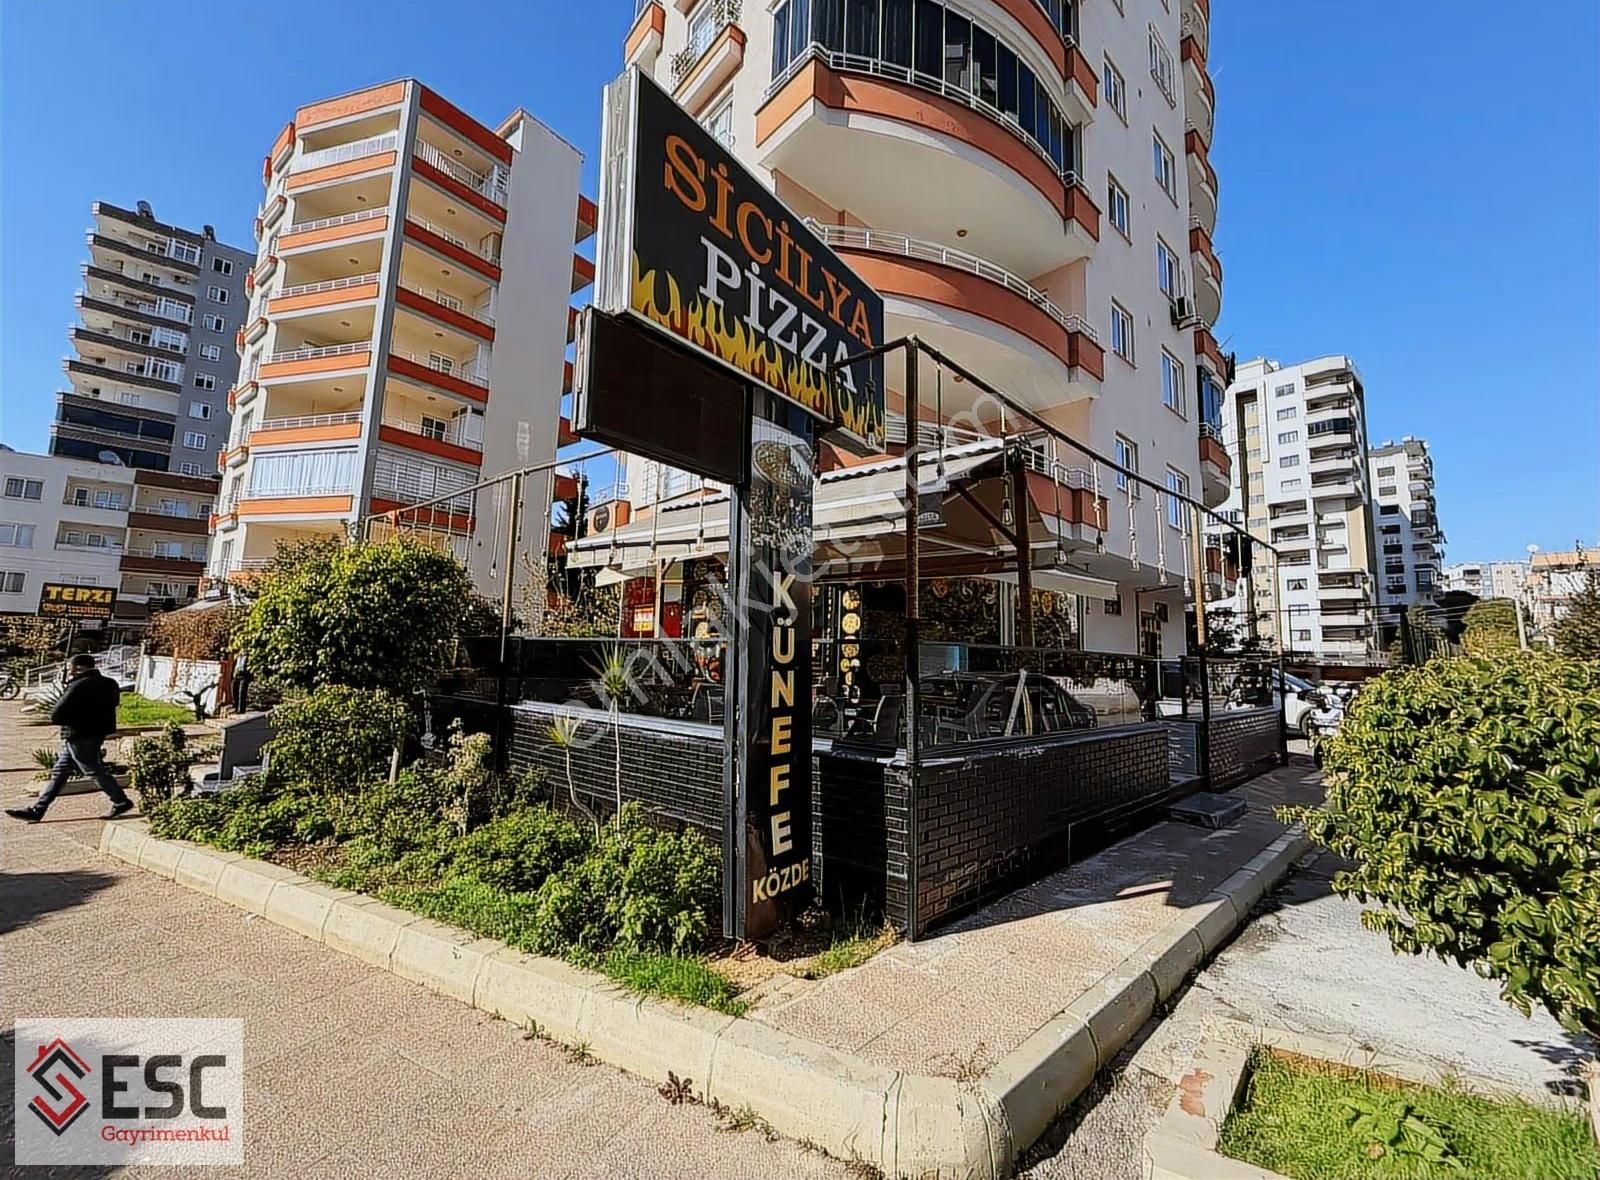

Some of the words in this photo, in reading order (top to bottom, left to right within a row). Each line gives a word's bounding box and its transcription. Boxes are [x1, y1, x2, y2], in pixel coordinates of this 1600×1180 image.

[664, 135, 873, 349] SİCİLYA
[700, 237, 858, 394] PİZZA
[770, 571, 797, 857] KÜNEFE
[752, 857, 810, 904] KÖZDE
